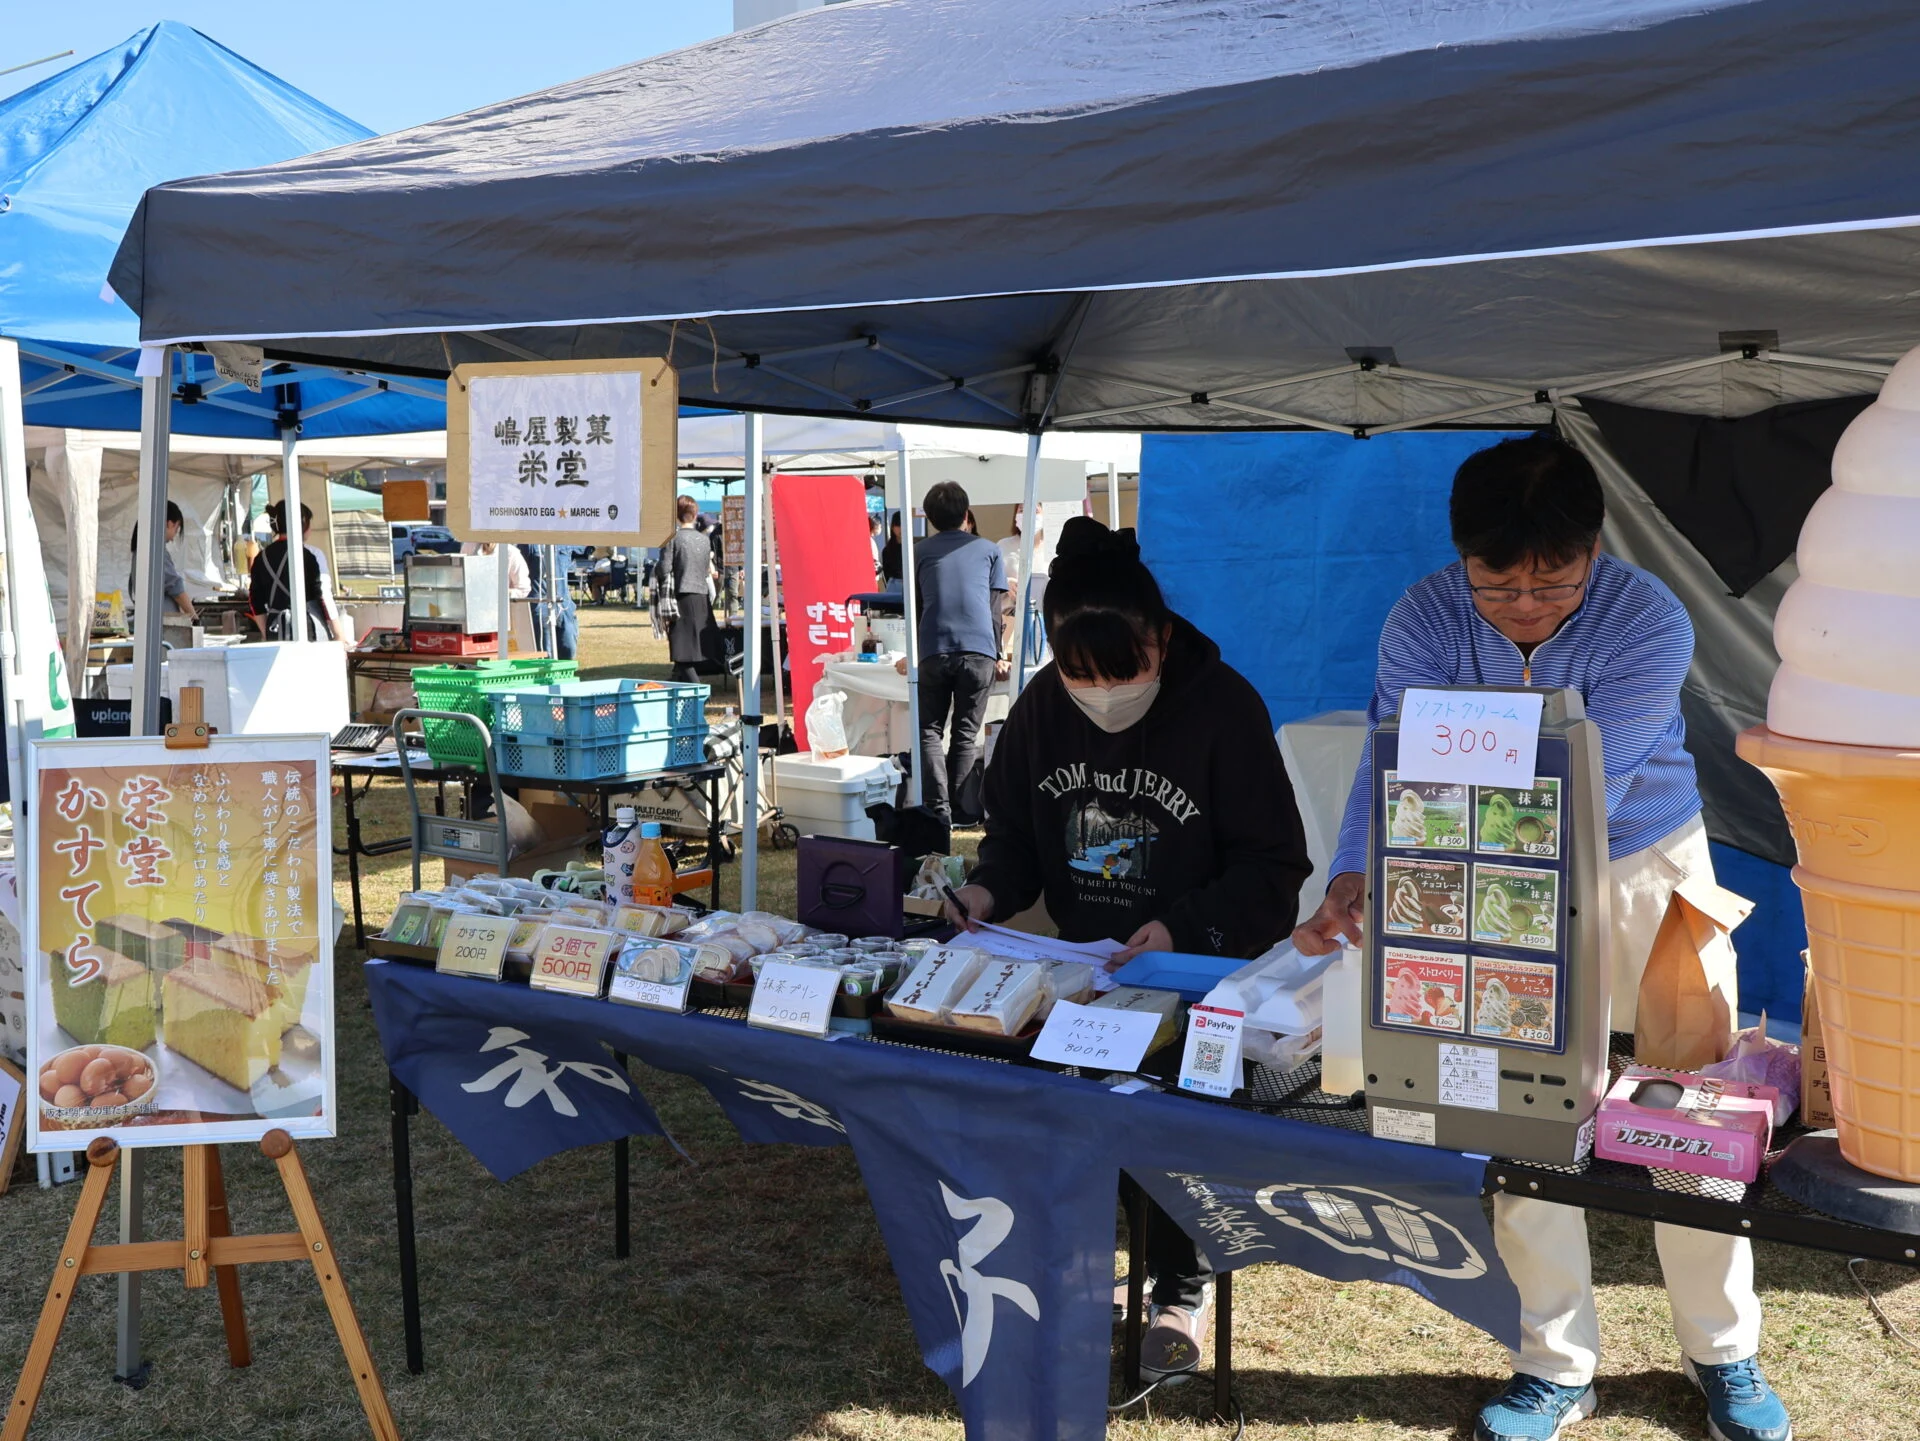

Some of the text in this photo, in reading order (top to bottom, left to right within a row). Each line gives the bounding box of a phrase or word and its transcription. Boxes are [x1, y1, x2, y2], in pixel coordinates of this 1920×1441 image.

[494, 414, 614, 446] 嶋屋製菓
[518, 450, 589, 487] 栄堂
[489, 507, 600, 517] HOSHINOSATO EGG MARCHE
[1415, 701, 1518, 720] ソフトクリーム
[1431, 724, 1518, 764] 300円
[1094, 769, 1127, 793] and
[1423, 787, 1462, 799] バニラ
[1518, 792, 1553, 807] 抹茶
[656, 807, 681, 817] CARRY
[118, 776, 172, 887] 栄堂
[215, 772, 232, 887] ふんわり食感と
[192, 773, 208, 923] なめらかな口あたり
[285, 769, 304, 937] 伝統のこだわり製法で
[53, 777, 109, 988] かすてら
[260, 770, 281, 986] 職人が丁寧に焼きあげました
[1421, 880, 1463, 890] チョコレート
[1530, 890, 1552, 900] 抹茶
[457, 927, 496, 942] かすてら
[455, 945, 487, 960] 200円
[551, 936, 598, 958] 3個で
[541, 957, 592, 980] 500円
[1419, 967, 1462, 979] ストロベリー
[622, 980, 675, 996] イタリアンロール
[1504, 975, 1545, 986] クッキーズ
[637, 991, 660, 1004] 180円
[1524, 986, 1550, 995] バニラ
[767, 1005, 811, 1023] 200円
[1072, 1018, 1121, 1034] カステラ
[1207, 1019, 1236, 1032] PayPay
[1068, 1032, 1104, 1042] ハーフ
[1064, 1043, 1110, 1058] 800円
[1462, 1070, 1478, 1079] 注意
[1616, 1127, 1714, 1156] フレッシュエンボス
